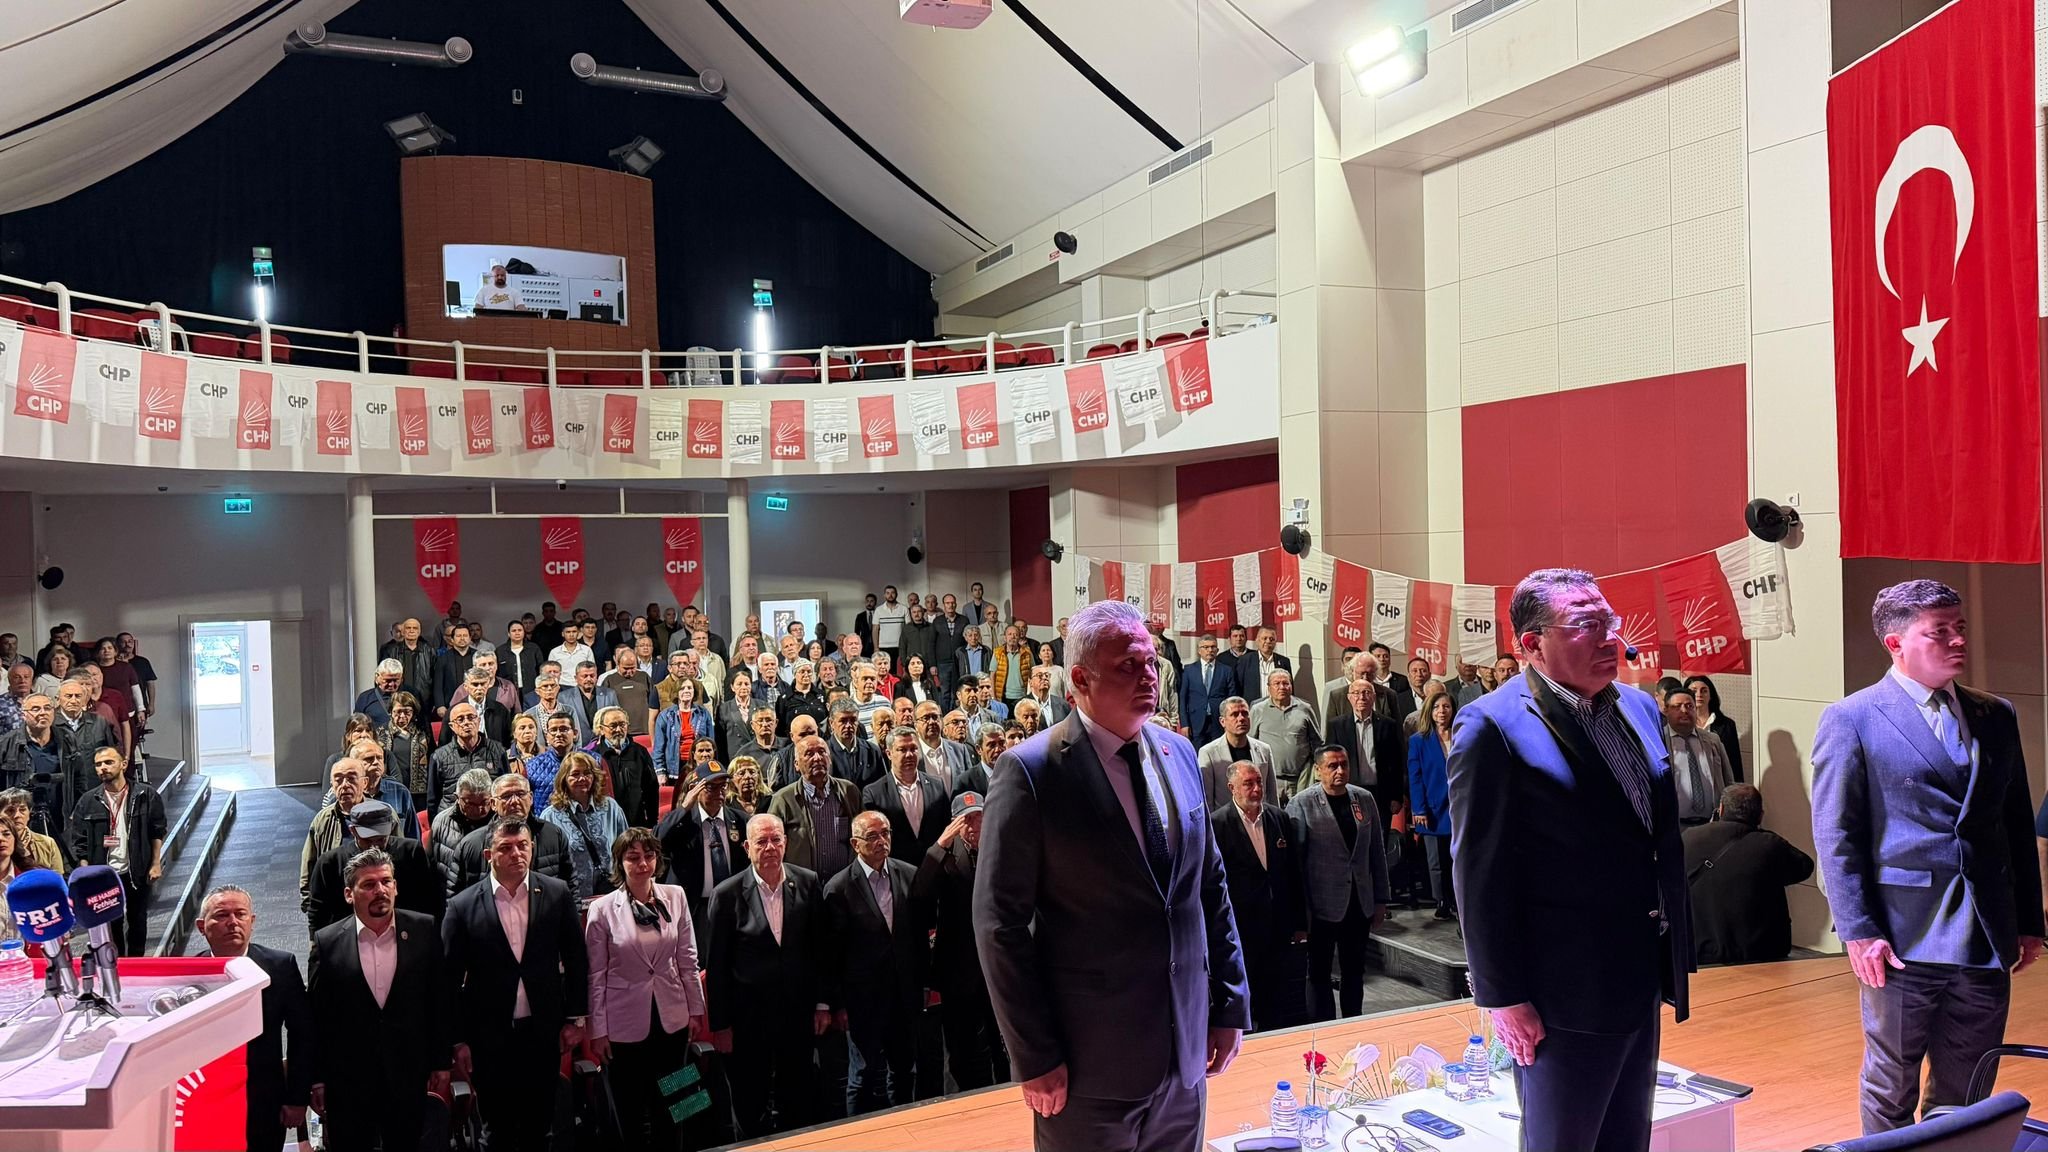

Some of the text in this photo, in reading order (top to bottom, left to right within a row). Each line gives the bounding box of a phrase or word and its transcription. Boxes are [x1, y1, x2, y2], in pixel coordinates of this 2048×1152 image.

[99, 364, 131, 382] CHP
[200, 382, 228, 399] CHP
[1130, 388, 1157, 404] CHP
[288, 395, 309, 409] CHP
[1180, 390, 1208, 406] CHP
[27, 395, 63, 415] CHP
[366, 402, 388, 415] CHP
[438, 405, 457, 417] CHP
[501, 405, 517, 416] CHP
[1024, 410, 1051, 424] CHP
[1077, 412, 1107, 427] CHP
[144, 417, 176, 433] CHP
[565, 422, 584, 434] CHP
[921, 423, 947, 437] CHP
[243, 430, 270, 443] CHP
[531, 434, 550, 444] CHP
[656, 431, 679, 441] CHP
[736, 434, 760, 445] CHP
[822, 432, 847, 444] CHP
[966, 431, 994, 445] CHP
[327, 437, 350, 449] CHP
[403, 439, 426, 451] CHP
[472, 438, 492, 449] CHP
[609, 438, 631, 449] CHP
[692, 443, 717, 455] CHP
[867, 441, 893, 453] CHP
[774, 445, 800, 456] CHP
[421, 564, 456, 578] CHP
[545, 561, 579, 575] CHP
[666, 561, 698, 574] CHP
[1307, 577, 1328, 595] CHP
[1177, 598, 1192, 609] CHP
[1276, 603, 1296, 617] CHP
[1377, 602, 1401, 620] CHP
[1152, 613, 1167, 623] CHP
[1207, 612, 1225, 625] CHP
[1337, 623, 1361, 642] CHP
[1464, 618, 1492, 634] CHP
[1685, 635, 1728, 658] CHP
[13, 902, 59, 926] FRT
